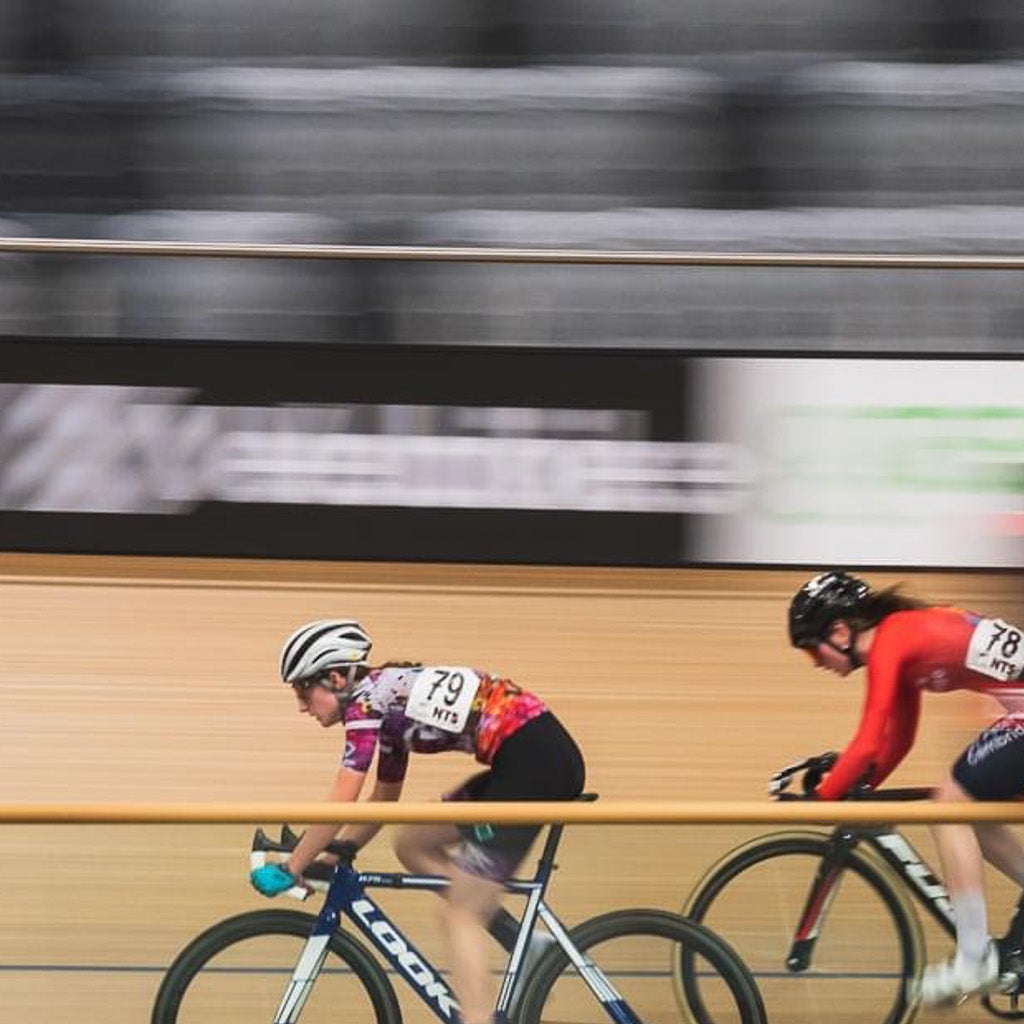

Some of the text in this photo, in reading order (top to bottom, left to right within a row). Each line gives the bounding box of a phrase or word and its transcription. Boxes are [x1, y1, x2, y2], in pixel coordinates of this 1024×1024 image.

[985, 622, 1022, 659] 78
[426, 669, 465, 707] 79
[351, 898, 462, 1019] LOOK
